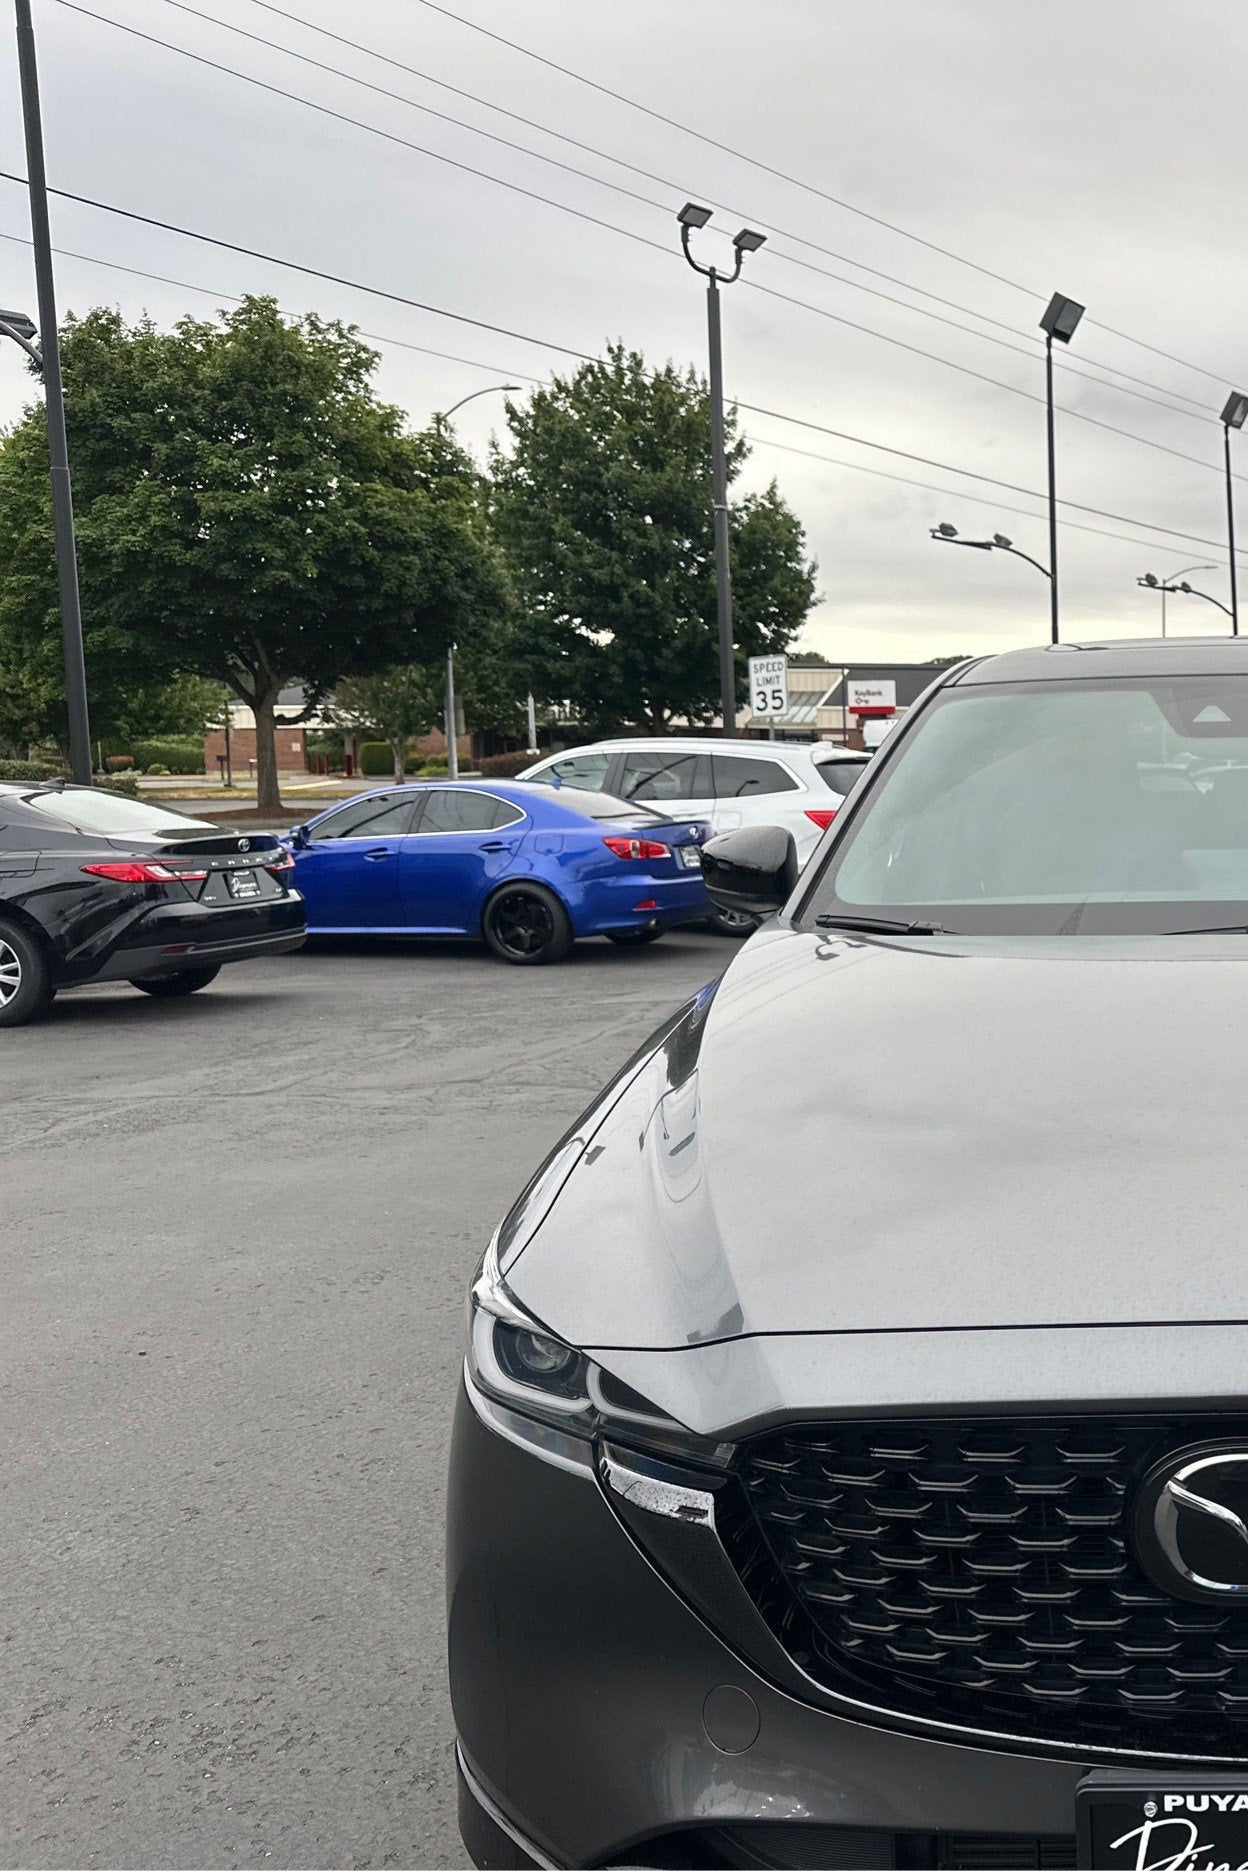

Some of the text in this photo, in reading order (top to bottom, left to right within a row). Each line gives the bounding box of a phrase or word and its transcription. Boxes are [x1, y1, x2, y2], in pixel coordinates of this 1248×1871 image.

[753, 661, 783, 674] SPEED
[756, 675, 781, 687] LIMIT
[854, 689, 883, 697] KeyBank
[756, 689, 784, 711] 35
